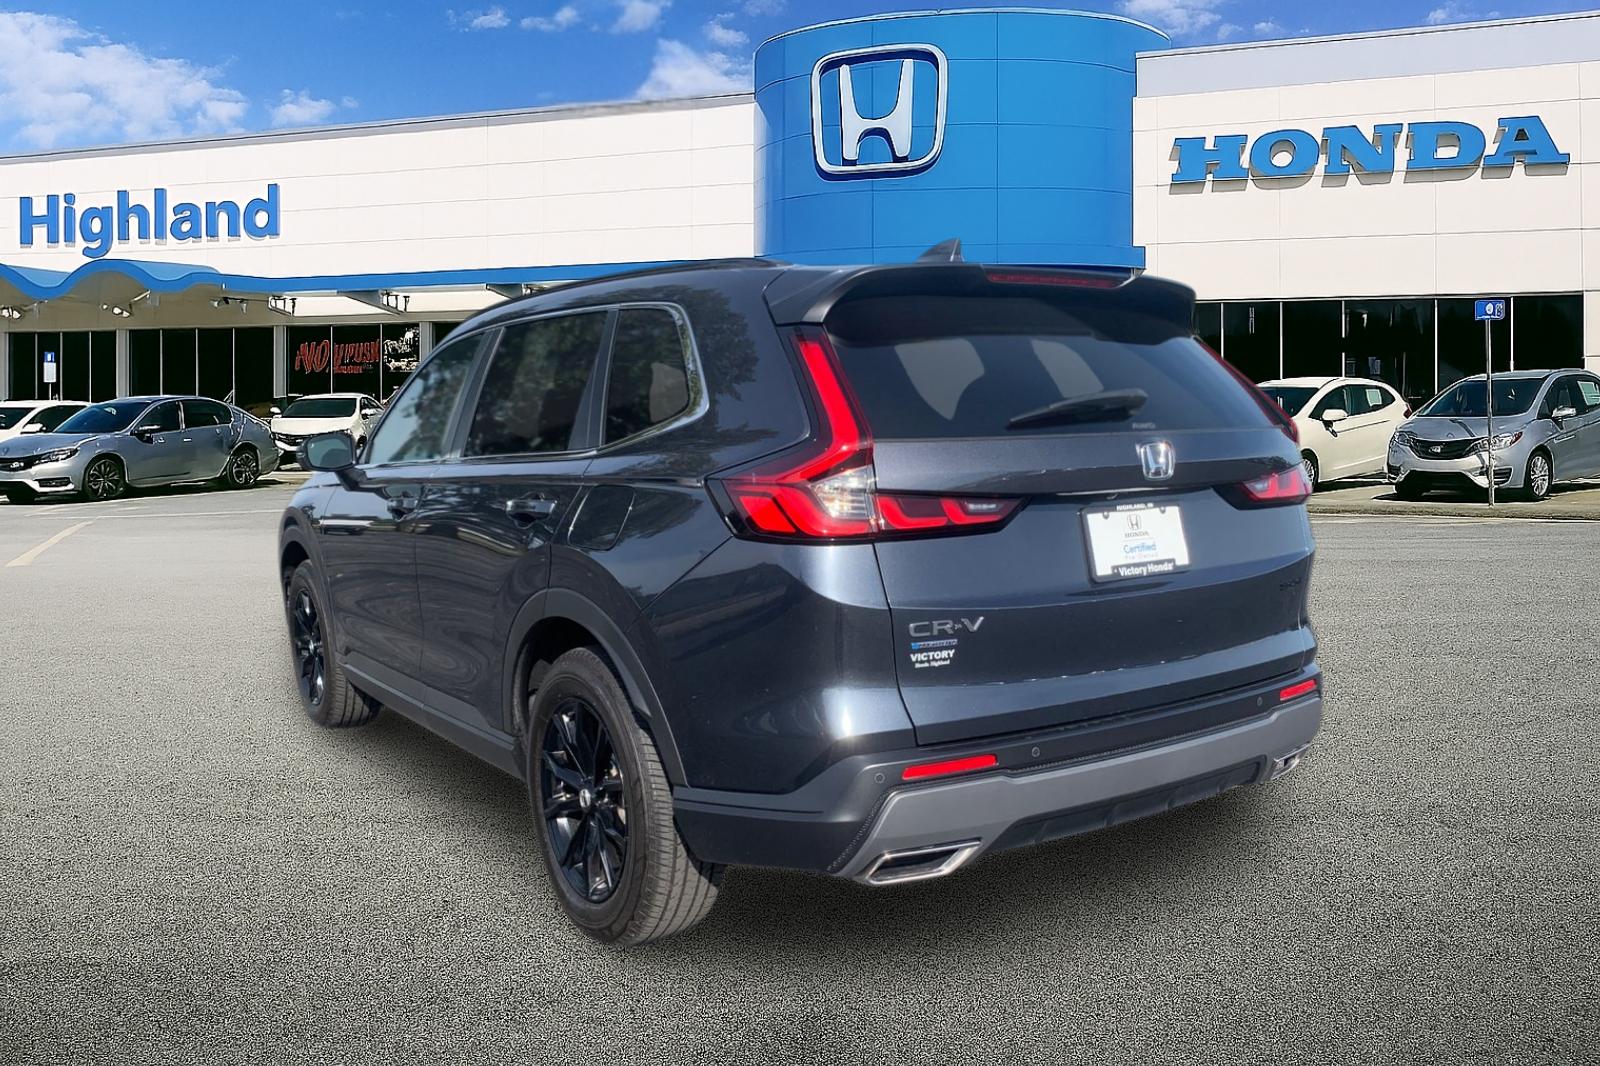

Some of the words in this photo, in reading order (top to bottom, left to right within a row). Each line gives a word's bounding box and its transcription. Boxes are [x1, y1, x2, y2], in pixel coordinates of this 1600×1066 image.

[1170, 115, 1571, 183] HONDA
[19, 183, 281, 258] Highland
[1118, 566, 1147, 576] Victory
[910, 649, 955, 662] VICTORY
